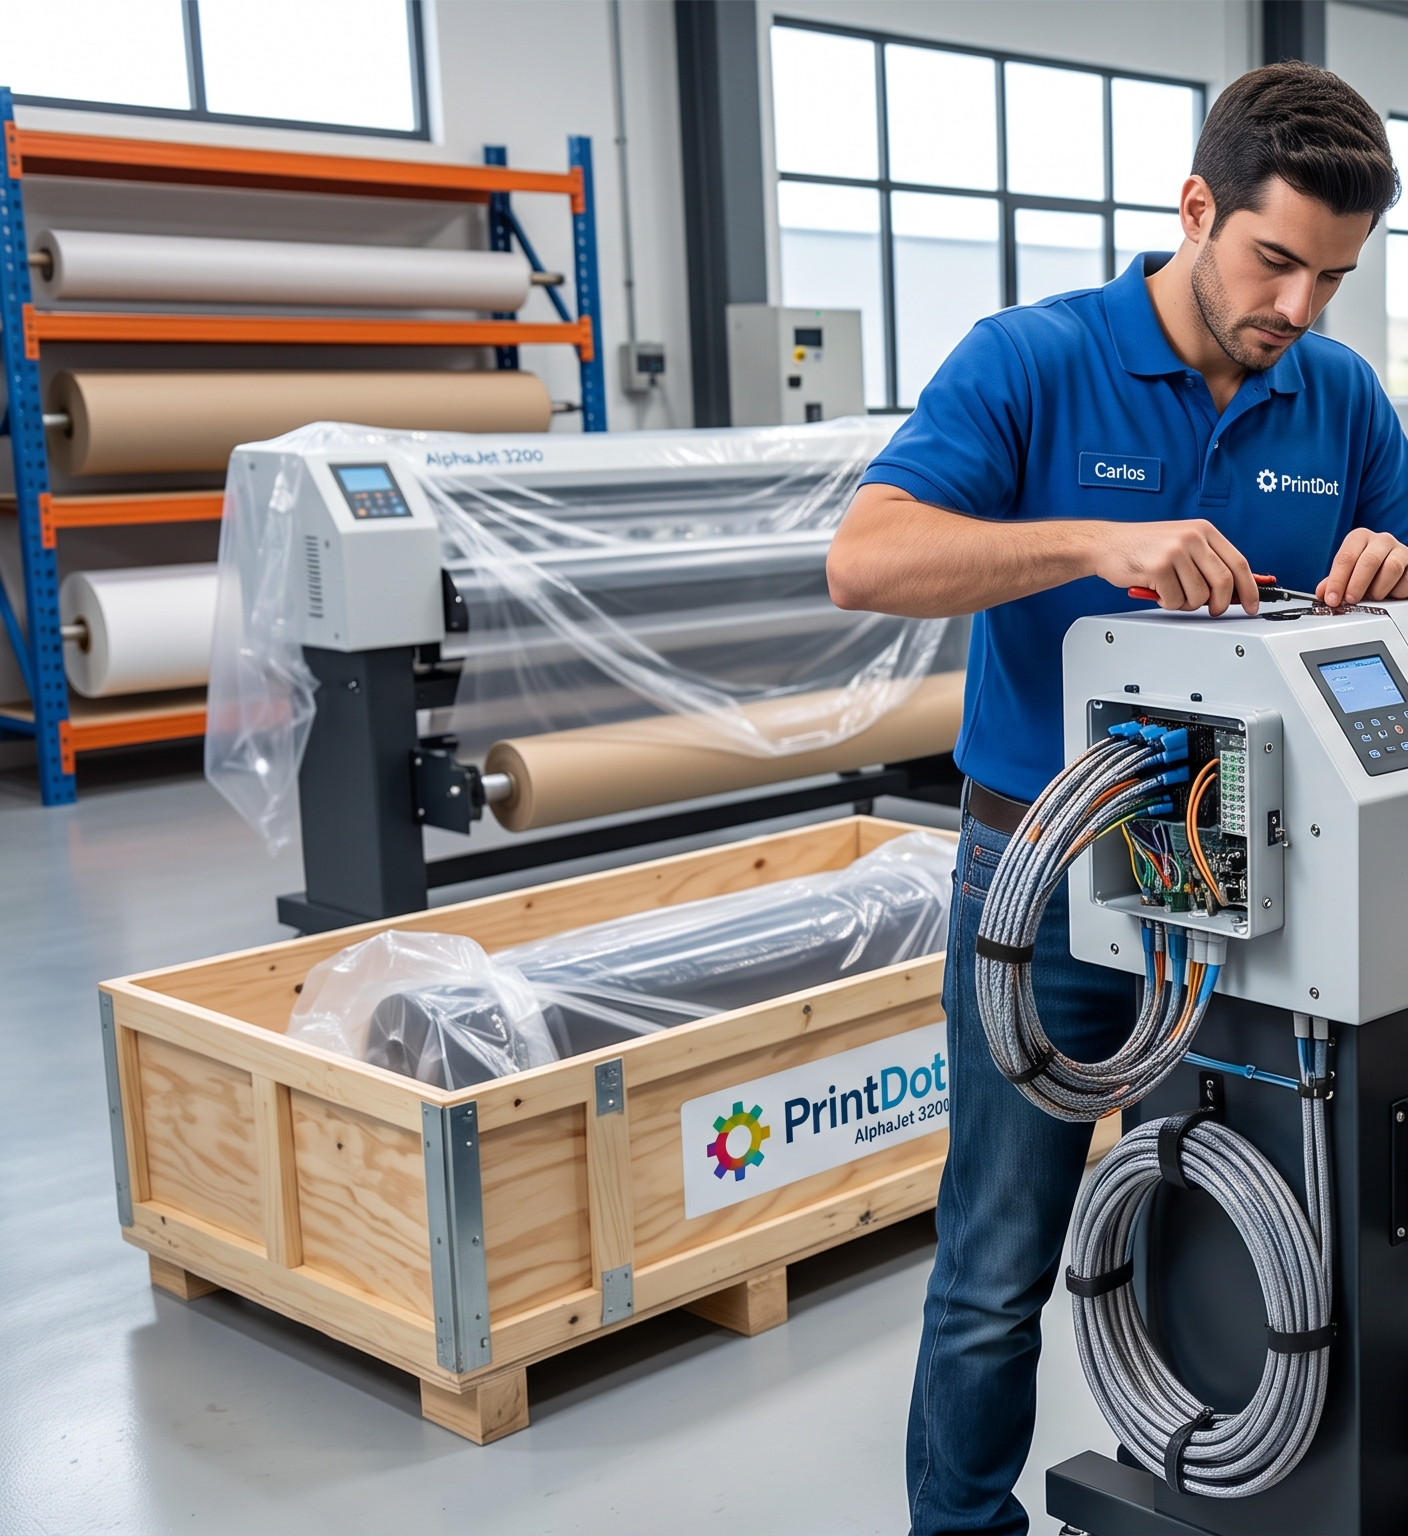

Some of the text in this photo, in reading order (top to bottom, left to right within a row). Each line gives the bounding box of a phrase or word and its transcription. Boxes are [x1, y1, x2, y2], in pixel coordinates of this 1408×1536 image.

[1095, 462, 1146, 481] Carlos
[1281, 475, 1339, 496] PrintDot
[784, 1052, 946, 1144] PrintDot
[855, 1098, 949, 1144] AlphaJet 3200
